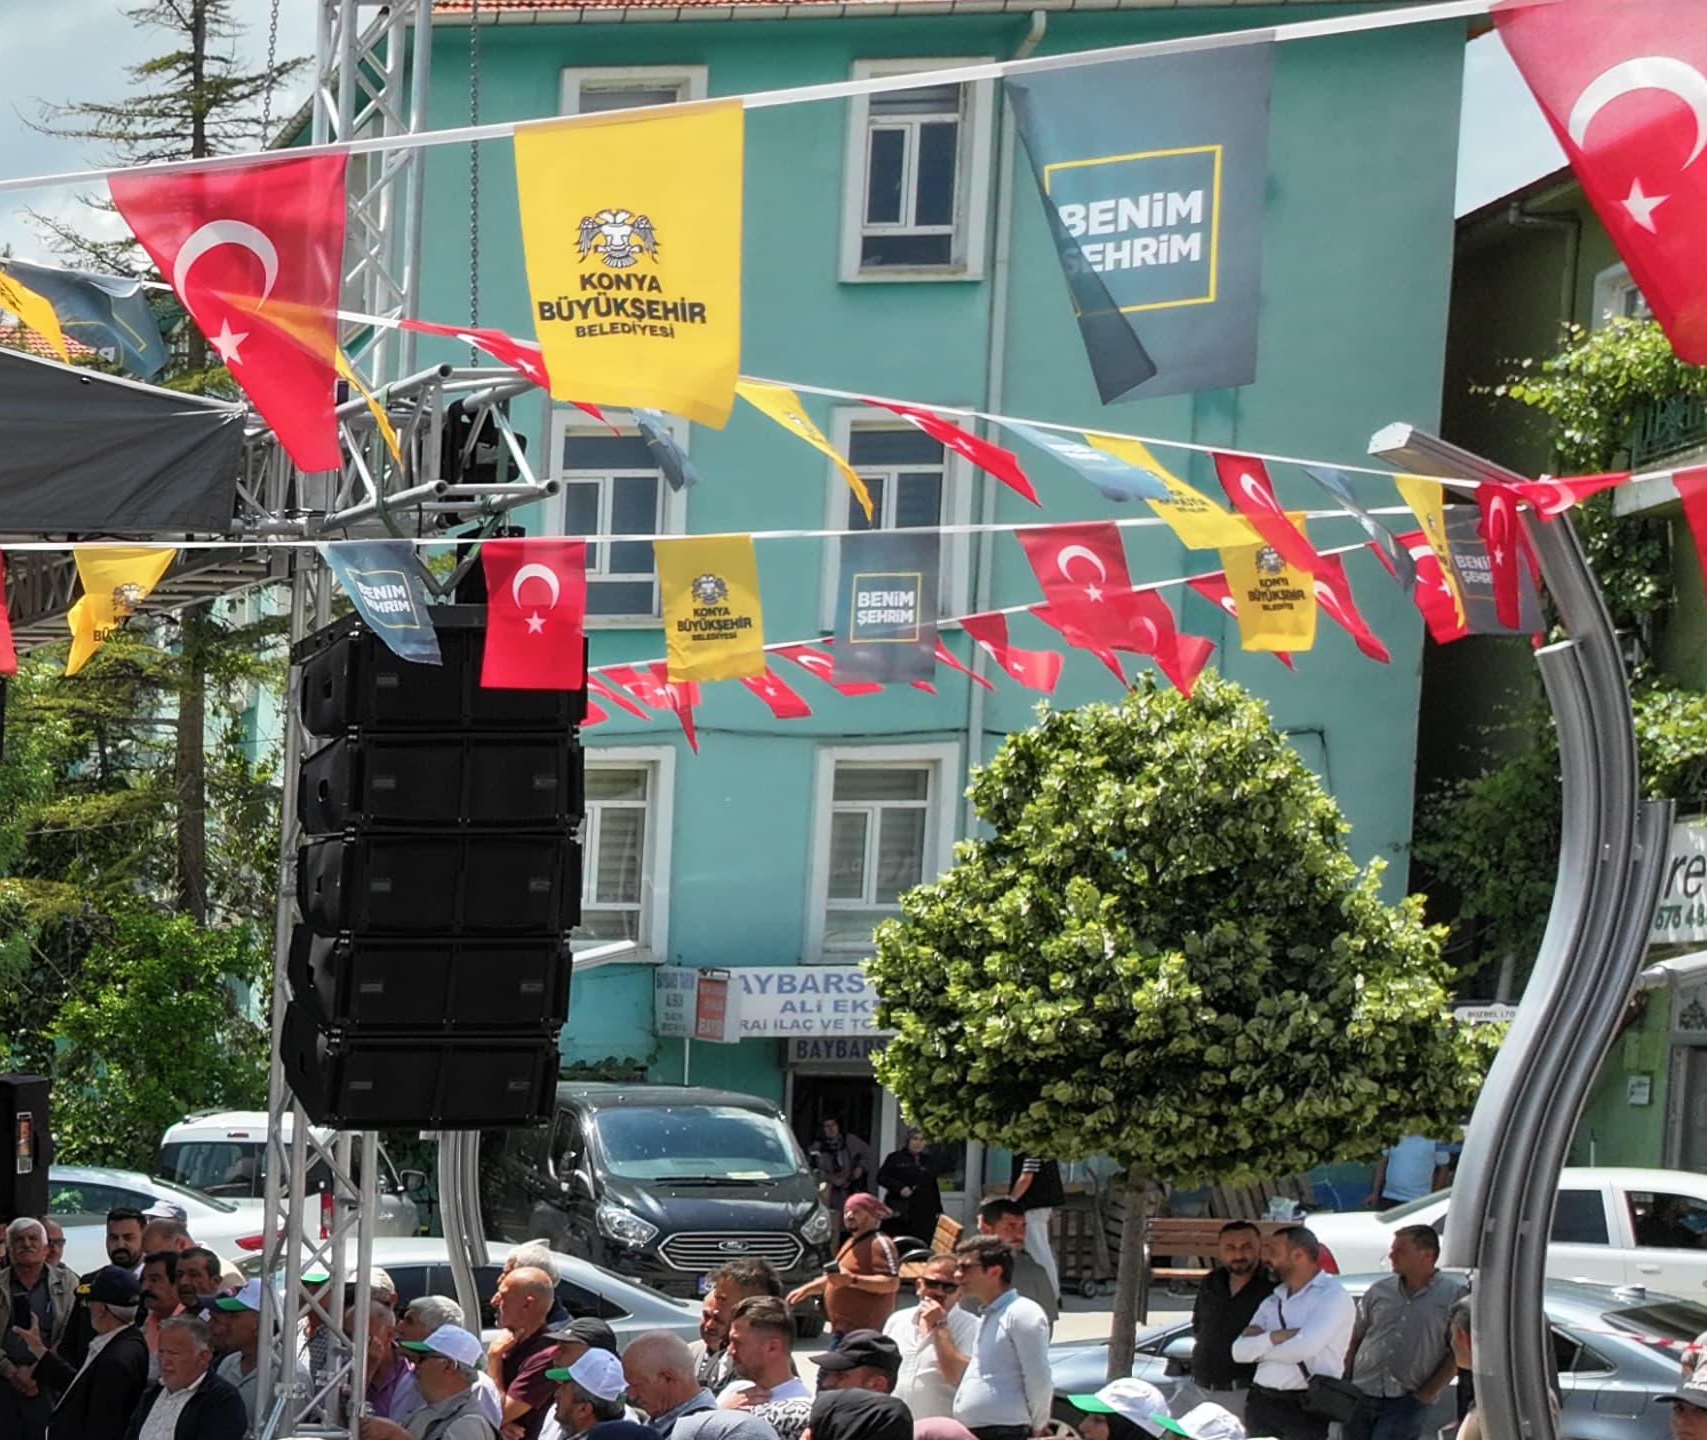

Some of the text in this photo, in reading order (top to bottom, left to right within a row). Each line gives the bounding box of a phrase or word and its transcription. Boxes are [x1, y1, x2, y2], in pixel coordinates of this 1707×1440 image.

[579, 272, 663, 293] KONYA
[538, 292, 707, 324] BÜYÜKŞEHİR
[575, 320, 676, 338] BELEDİYESİ
[693, 607, 731, 617] KONYA
[676, 617, 752, 633] BÜYÜKŞEHİR
